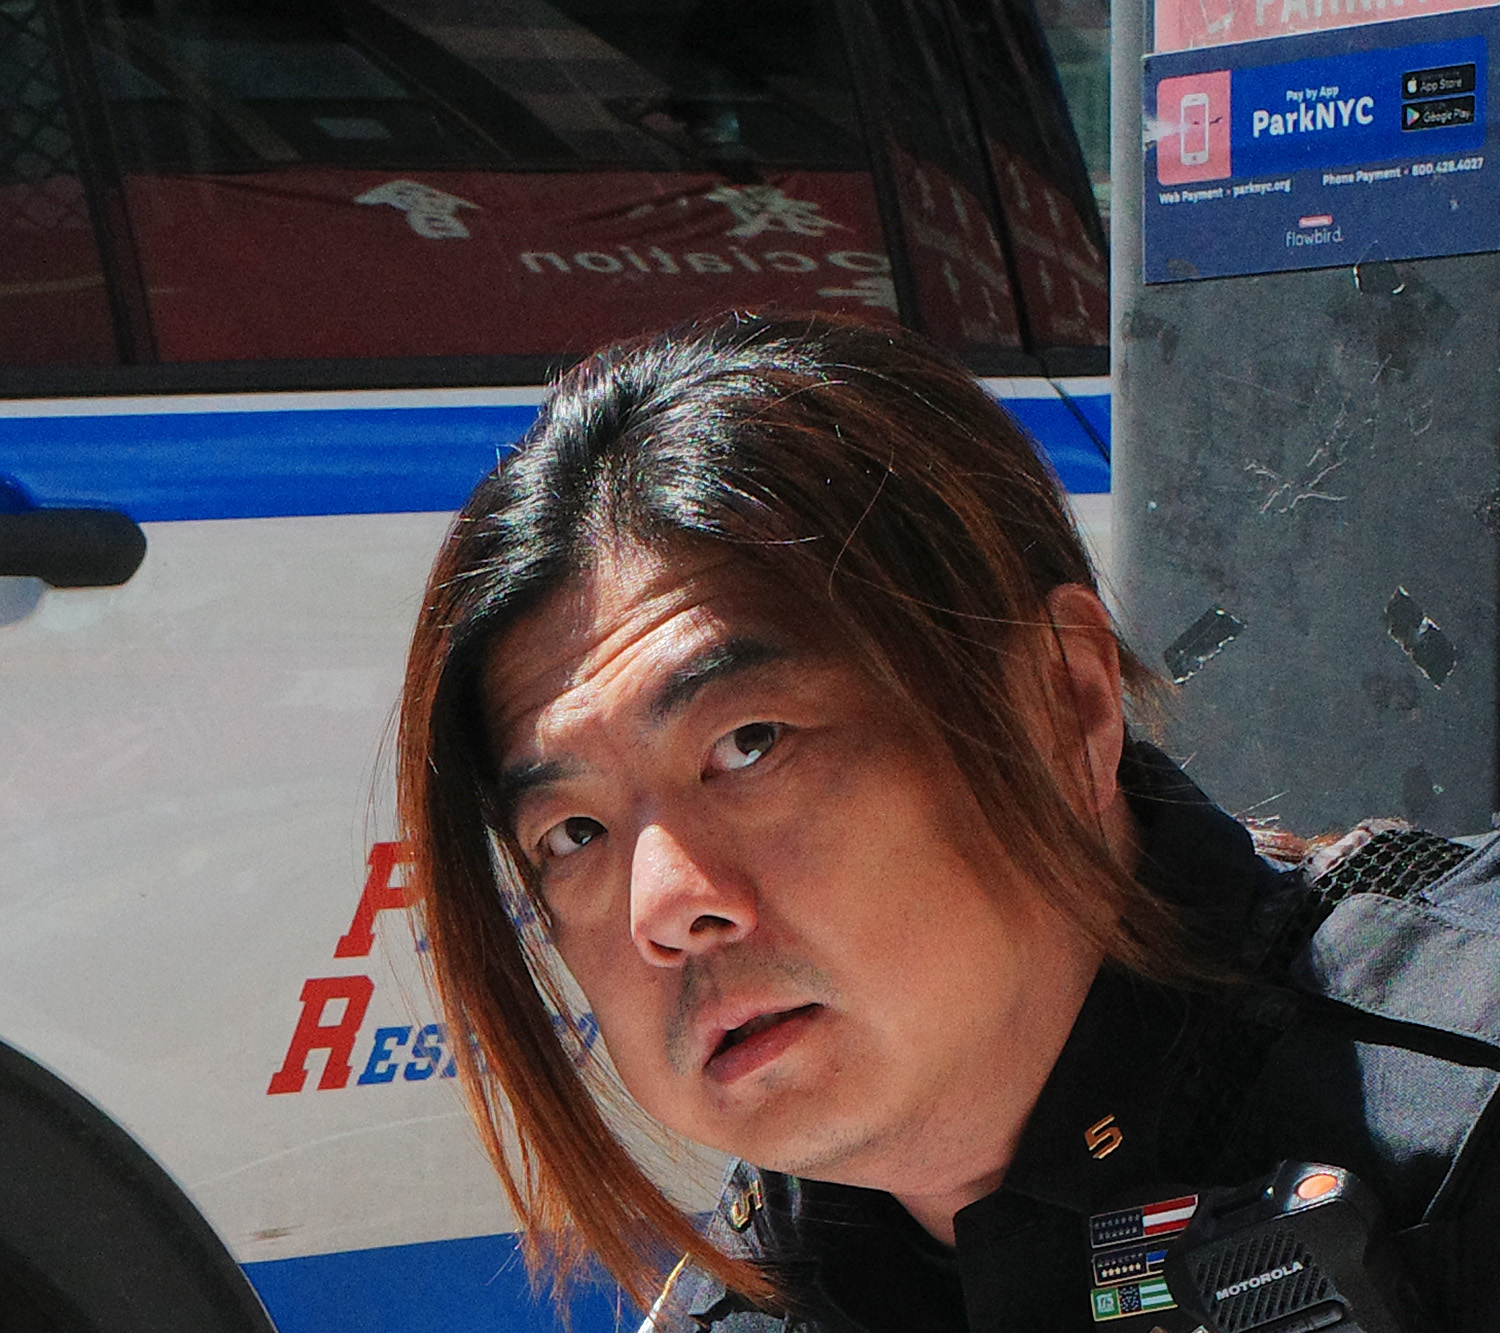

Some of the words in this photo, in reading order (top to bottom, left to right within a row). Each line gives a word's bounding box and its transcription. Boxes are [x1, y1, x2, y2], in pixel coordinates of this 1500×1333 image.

[1286, 89, 1304, 103] Pay
[1305, 88, 1318, 101] by
[1319, 85, 1339, 99] App
[1252, 95, 1375, 138] ParkNYC
[1322, 172, 1355, 186] Phone
[1355, 167, 1401, 183] Payment
[1158, 192, 1180, 204] Web
[1181, 187, 1223, 204] Payment
[1215, 1260, 1304, 1301] MOTOROLA
